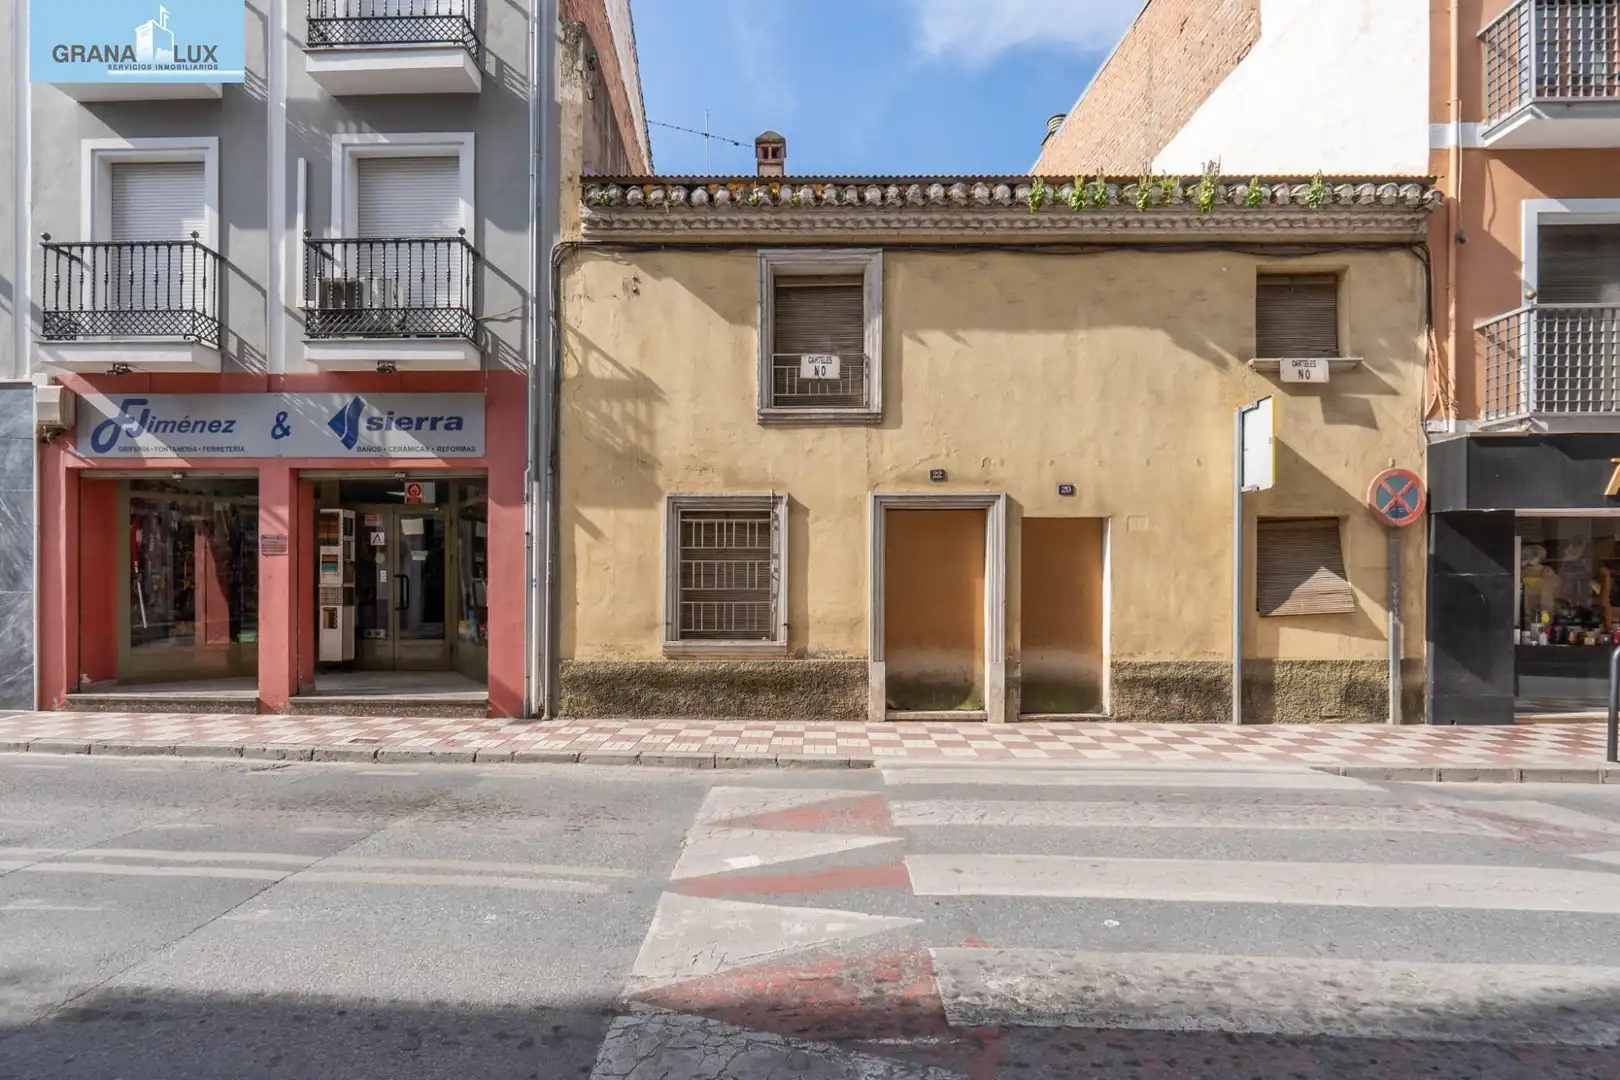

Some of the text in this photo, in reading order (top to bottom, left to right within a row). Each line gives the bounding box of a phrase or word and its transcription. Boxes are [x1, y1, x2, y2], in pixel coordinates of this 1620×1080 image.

[807, 356, 833, 365] CARTELES
[1291, 360, 1317, 368] CARTELES
[814, 365, 827, 377] NO
[1298, 369, 1311, 380] NO
[270, 411, 291, 440] &
[365, 410, 464, 432] sierra
[356, 445, 381, 453] BAÑOS
[436, 445, 477, 453] REFORMAS
[1060, 485, 1072, 494] 20
